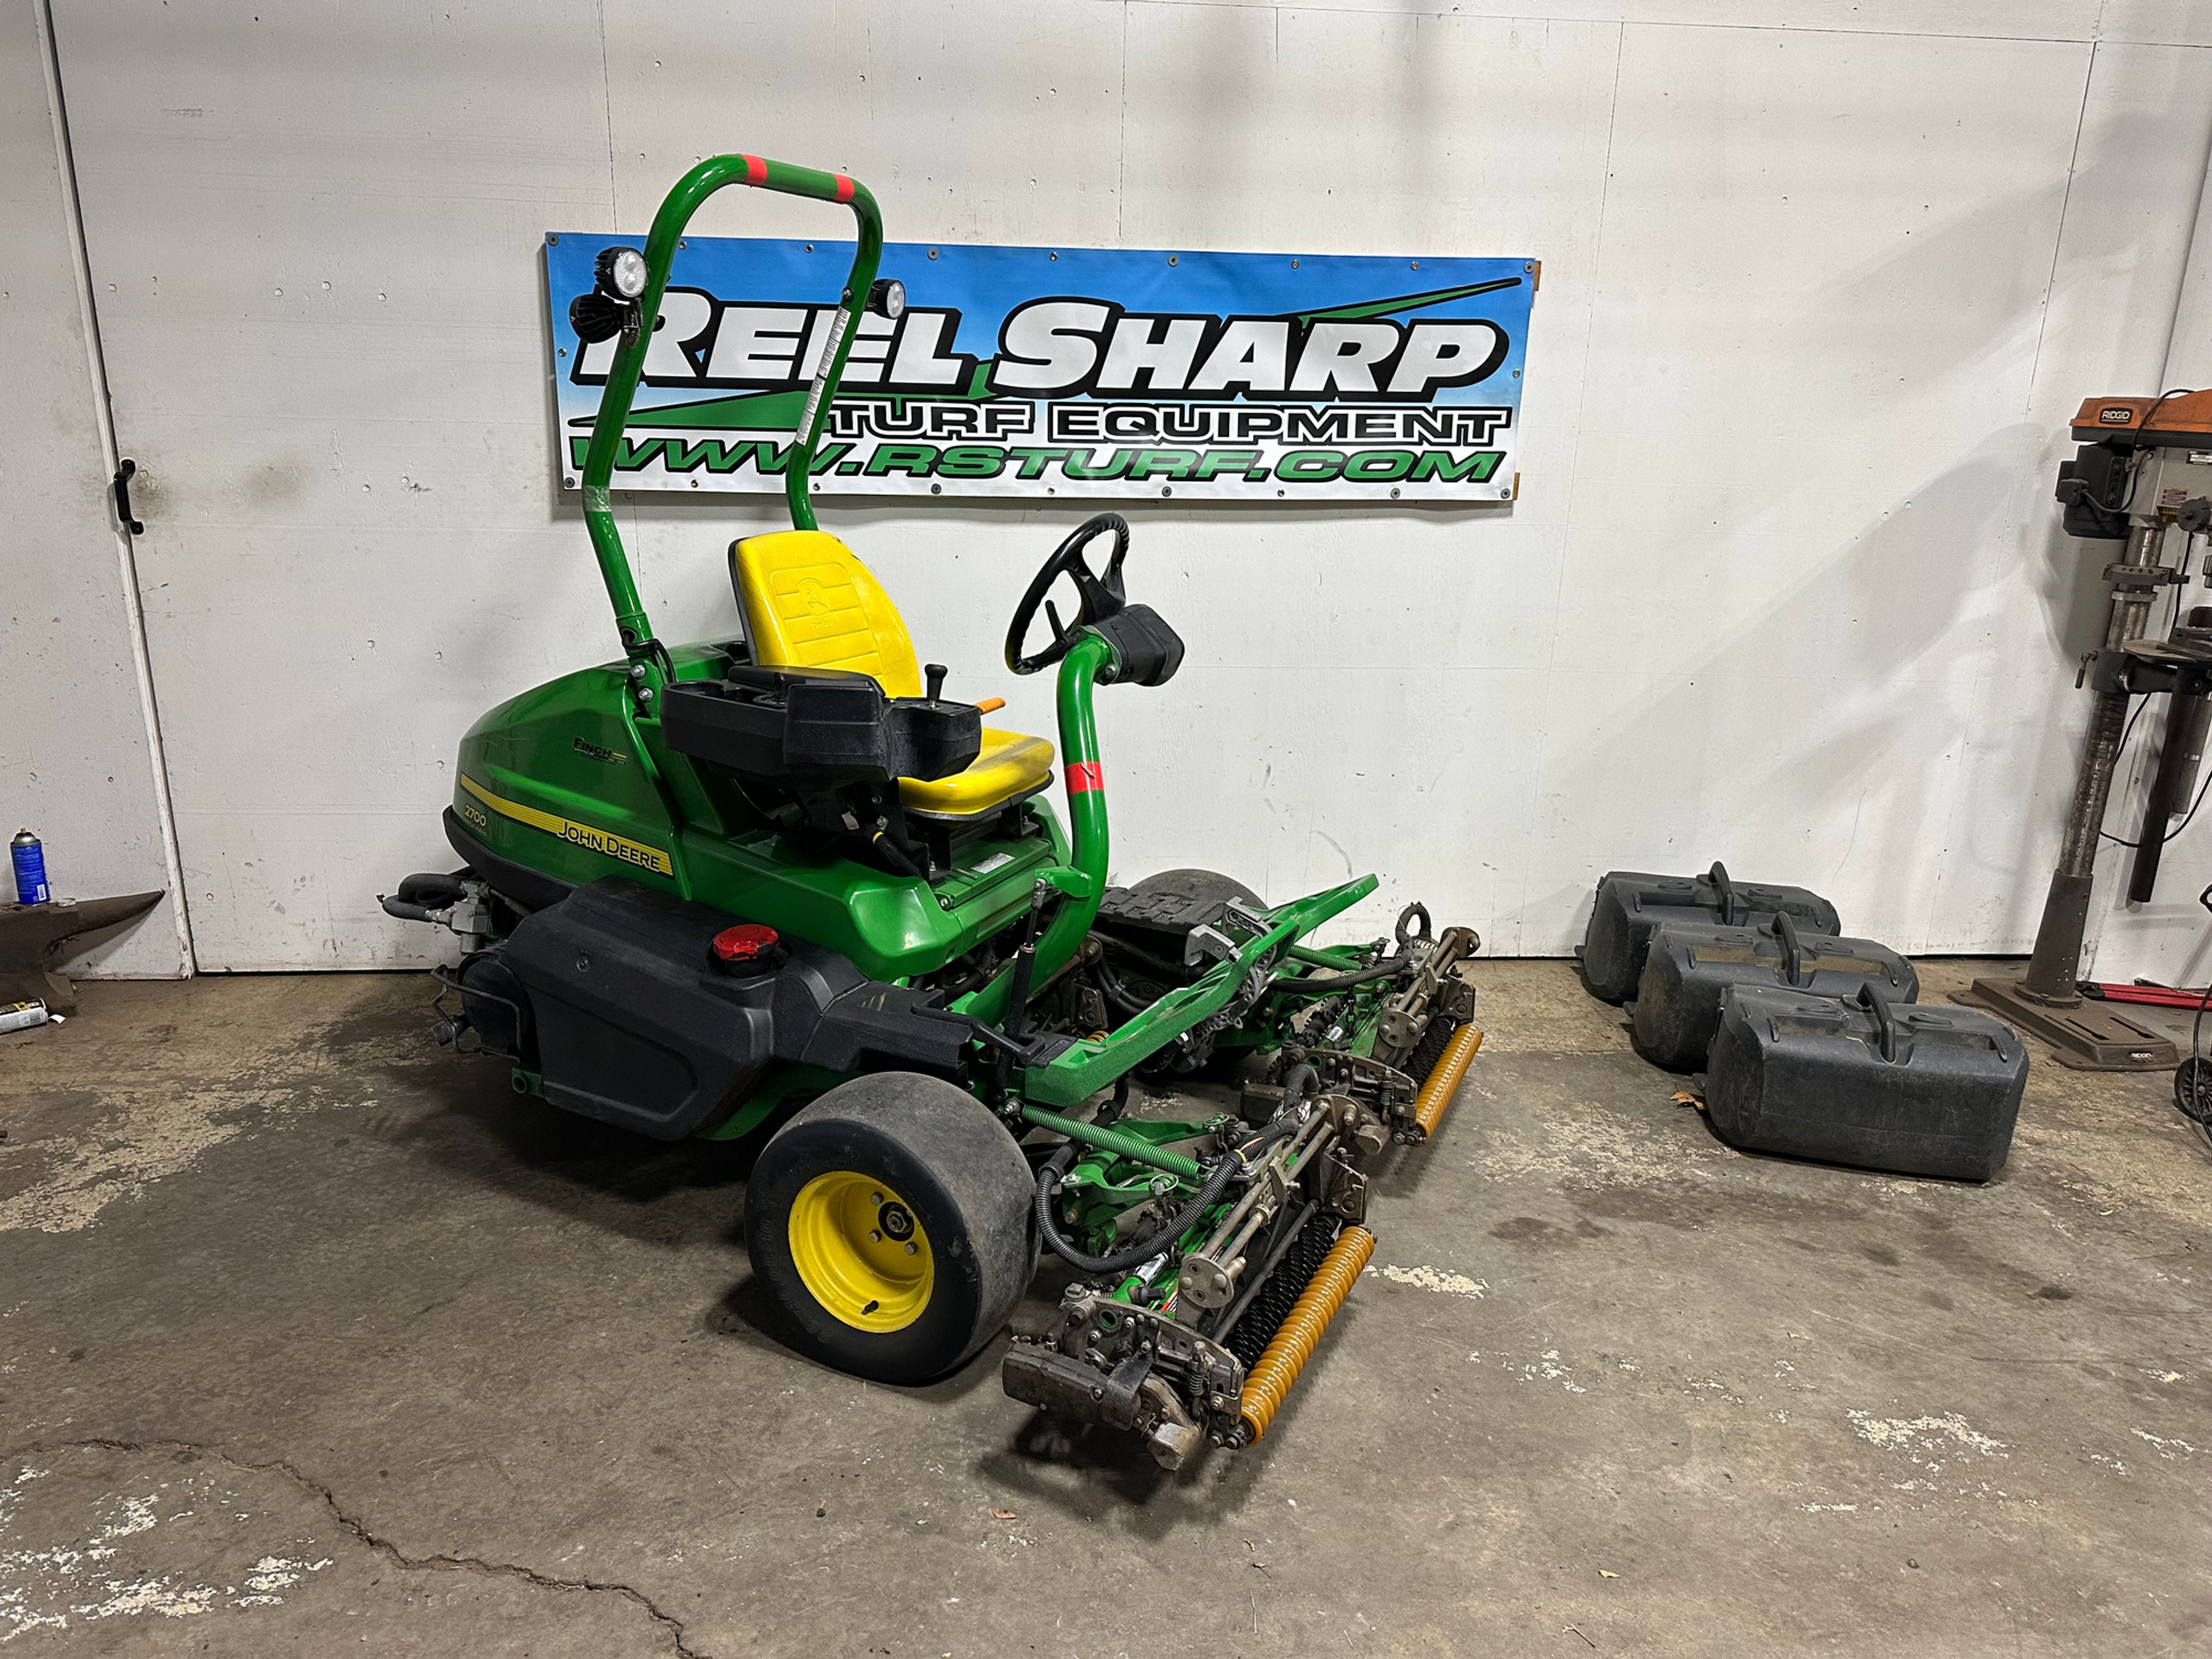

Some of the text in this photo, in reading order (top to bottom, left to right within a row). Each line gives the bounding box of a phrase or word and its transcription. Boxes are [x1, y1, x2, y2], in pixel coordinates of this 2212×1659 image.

[579, 290, 964, 385] REEL
[992, 300, 1497, 393] SHARP
[830, 403, 1507, 443] TURF EQUIPMENT
[2102, 410, 2130, 419] RIDGID
[572, 438, 1504, 482] WWW.RSTURF.COM
[574, 737, 612, 758] FINCH
[465, 804, 487, 827] 2700
[558, 821, 660, 871] JOHN DEERE
